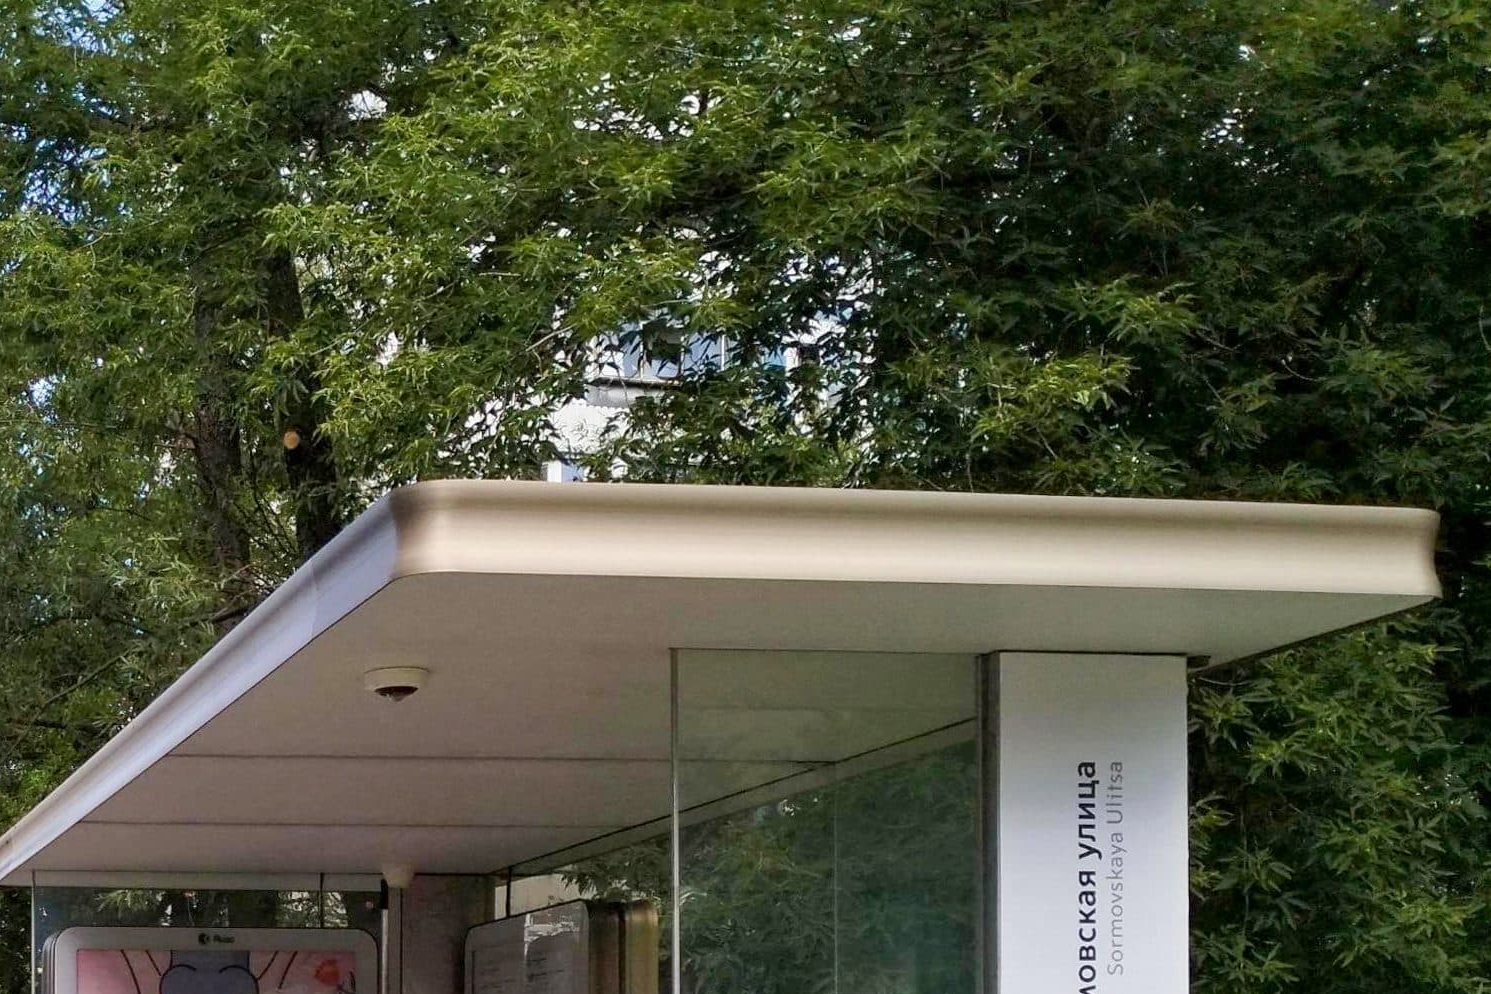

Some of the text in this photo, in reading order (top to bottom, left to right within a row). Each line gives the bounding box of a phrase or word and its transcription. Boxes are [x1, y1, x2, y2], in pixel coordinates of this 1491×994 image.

[1077, 761, 1103, 861] улица
[1105, 761, 1128, 977] Sormovskaya Ulitsa
